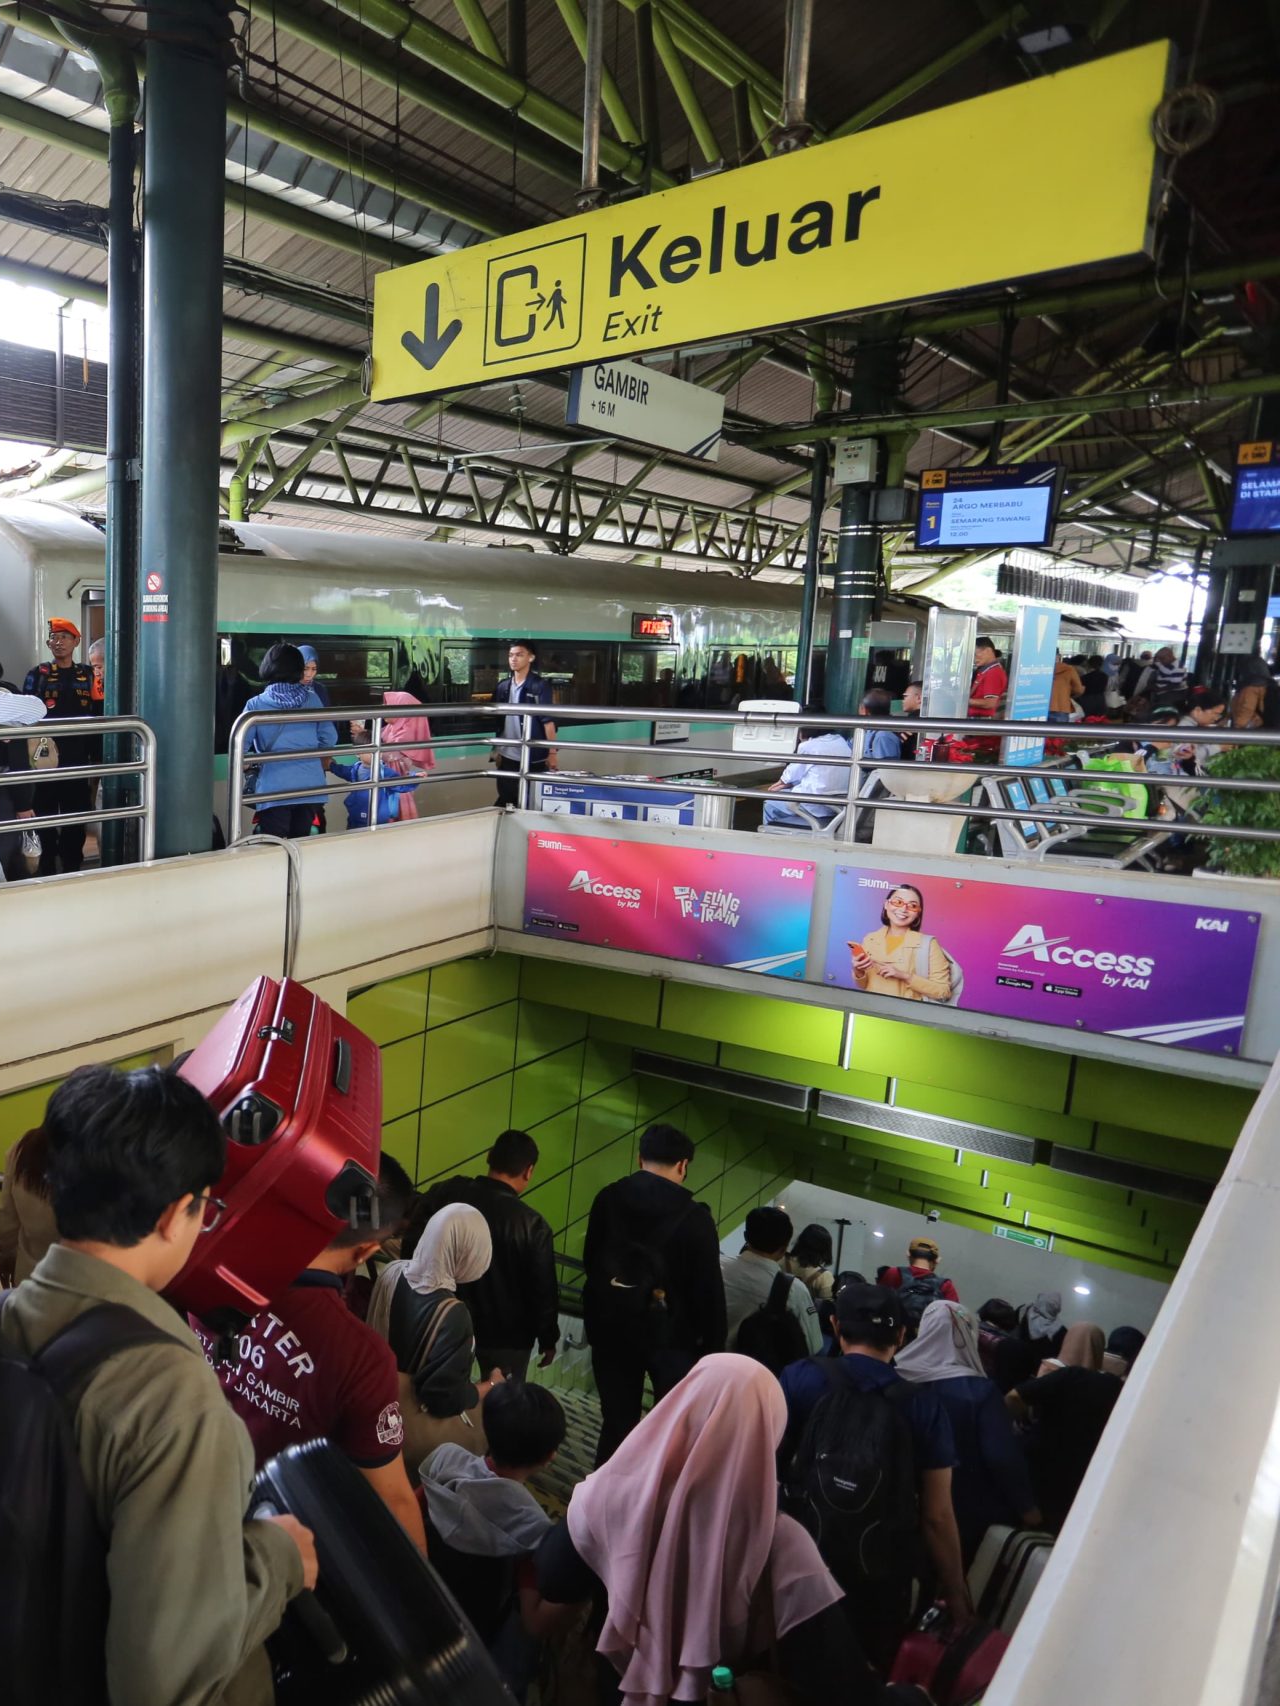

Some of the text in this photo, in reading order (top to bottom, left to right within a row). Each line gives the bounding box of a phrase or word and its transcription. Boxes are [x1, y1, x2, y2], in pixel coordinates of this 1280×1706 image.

[609, 185, 881, 298] Keluar
[602, 303, 663, 342] Exit
[594, 364, 649, 405] GAMBIR
[980, 501, 1023, 509] MERBABU
[1240, 491, 1251, 499] DI
[927, 516, 936, 528] 1
[781, 867, 804, 879] KAI
[568, 870, 642, 901] Access
[617, 900, 640, 909] by KAI
[1195, 917, 1230, 933] KAI
[1000, 924, 1155, 977] Access
[1101, 974, 1150, 991] by KAI
[246, 1371, 300, 1413] GAMBIR
[234, 1382, 301, 1430] JAKARTA
